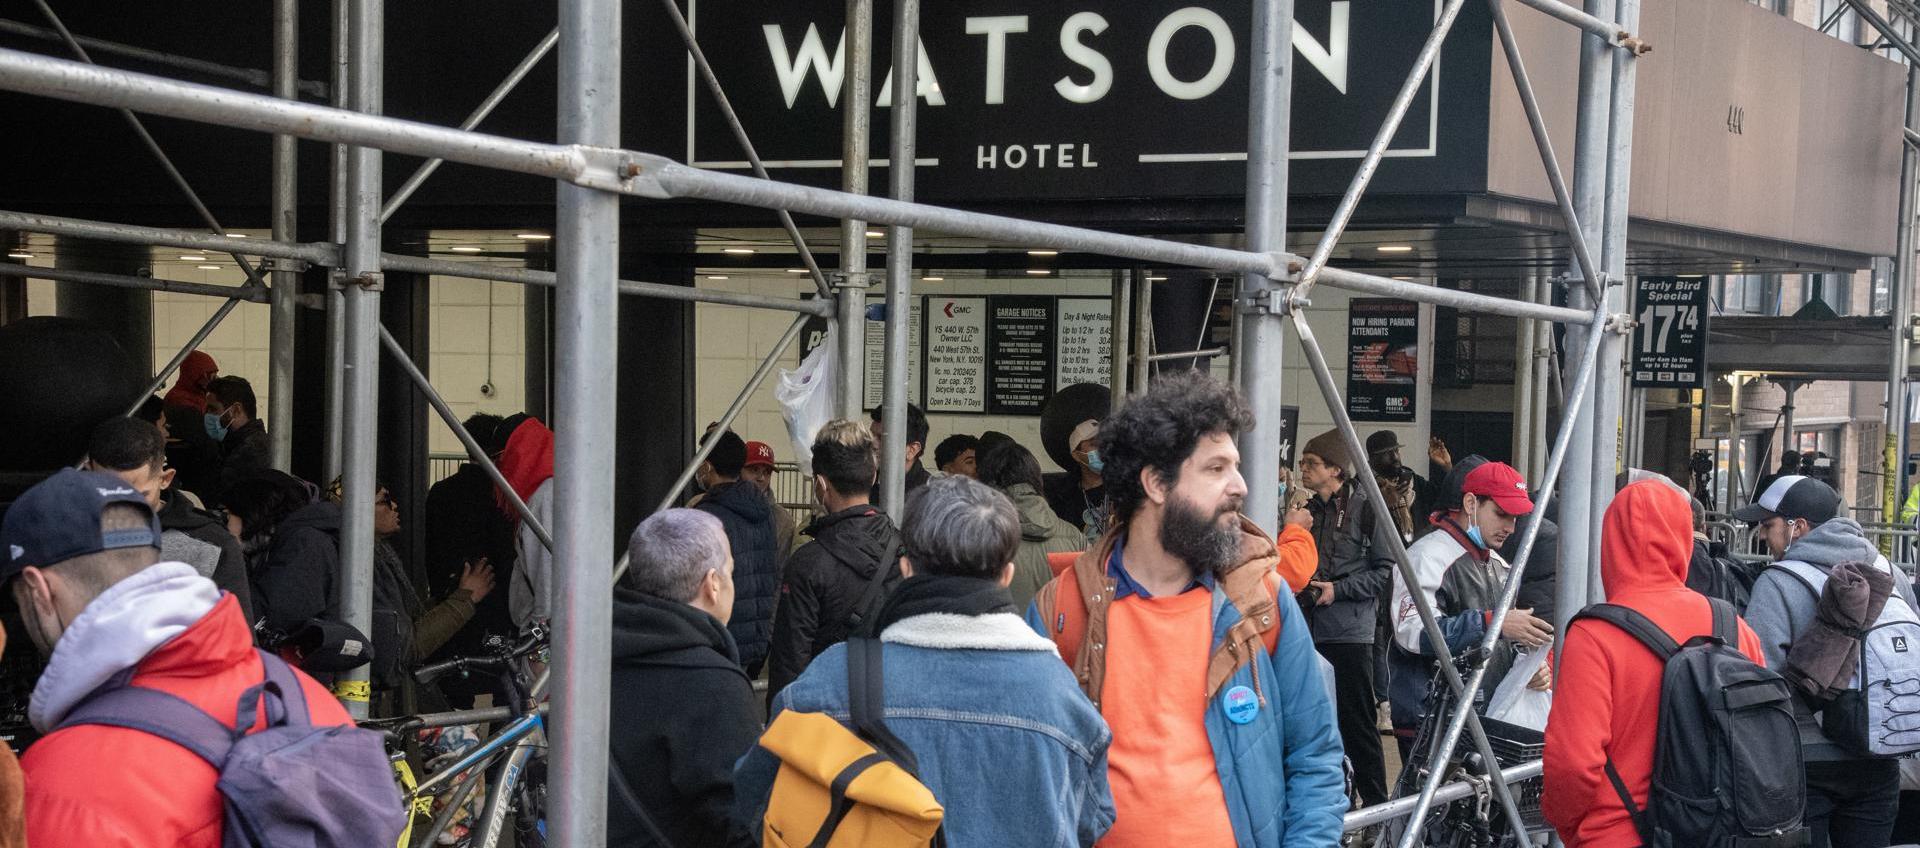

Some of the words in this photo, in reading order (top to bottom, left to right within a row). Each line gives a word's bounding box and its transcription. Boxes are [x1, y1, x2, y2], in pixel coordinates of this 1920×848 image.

[1727, 104, 1744, 135] 440
[977, 143, 1099, 169] HOTEL
[1640, 281, 1672, 292] Early
[1675, 281, 1701, 290] Bird
[1649, 291, 1693, 301] Special
[997, 308, 1020, 317] GARAGE
[1021, 308, 1046, 317] NOTICES
[1064, 313, 1075, 321] Day
[1082, 313, 1095, 322] Night
[1352, 317, 1365, 326] NOW
[1367, 317, 1387, 326] HIRING
[1390, 318, 1415, 326] PARKING
[966, 326, 979, 334] 57th
[1062, 326, 1070, 334] Up
[1072, 326, 1077, 334] to
[1352, 327, 1389, 336] ATTENDANTS
[1640, 305, 1676, 353] 17
[1677, 305, 1698, 330] 74
[941, 334, 960, 342] Owner
[961, 334, 973, 342] LLC
[1062, 336, 1069, 344] Up
[933, 345, 944, 353] 440
[1062, 346, 1069, 354] Up
[1077, 346, 1081, 354] 2
[930, 355, 941, 363] New
[968, 356, 983, 364] 10019
[1062, 356, 1068, 364] Up
[1079, 366, 1085, 374] 24
[936, 385, 954, 394] bicycle
[969, 385, 976, 393] 22
[930, 397, 943, 407] Open
[944, 398, 951, 406] 24
[968, 399, 981, 407] Days
[1385, 397, 1403, 406] GMC
